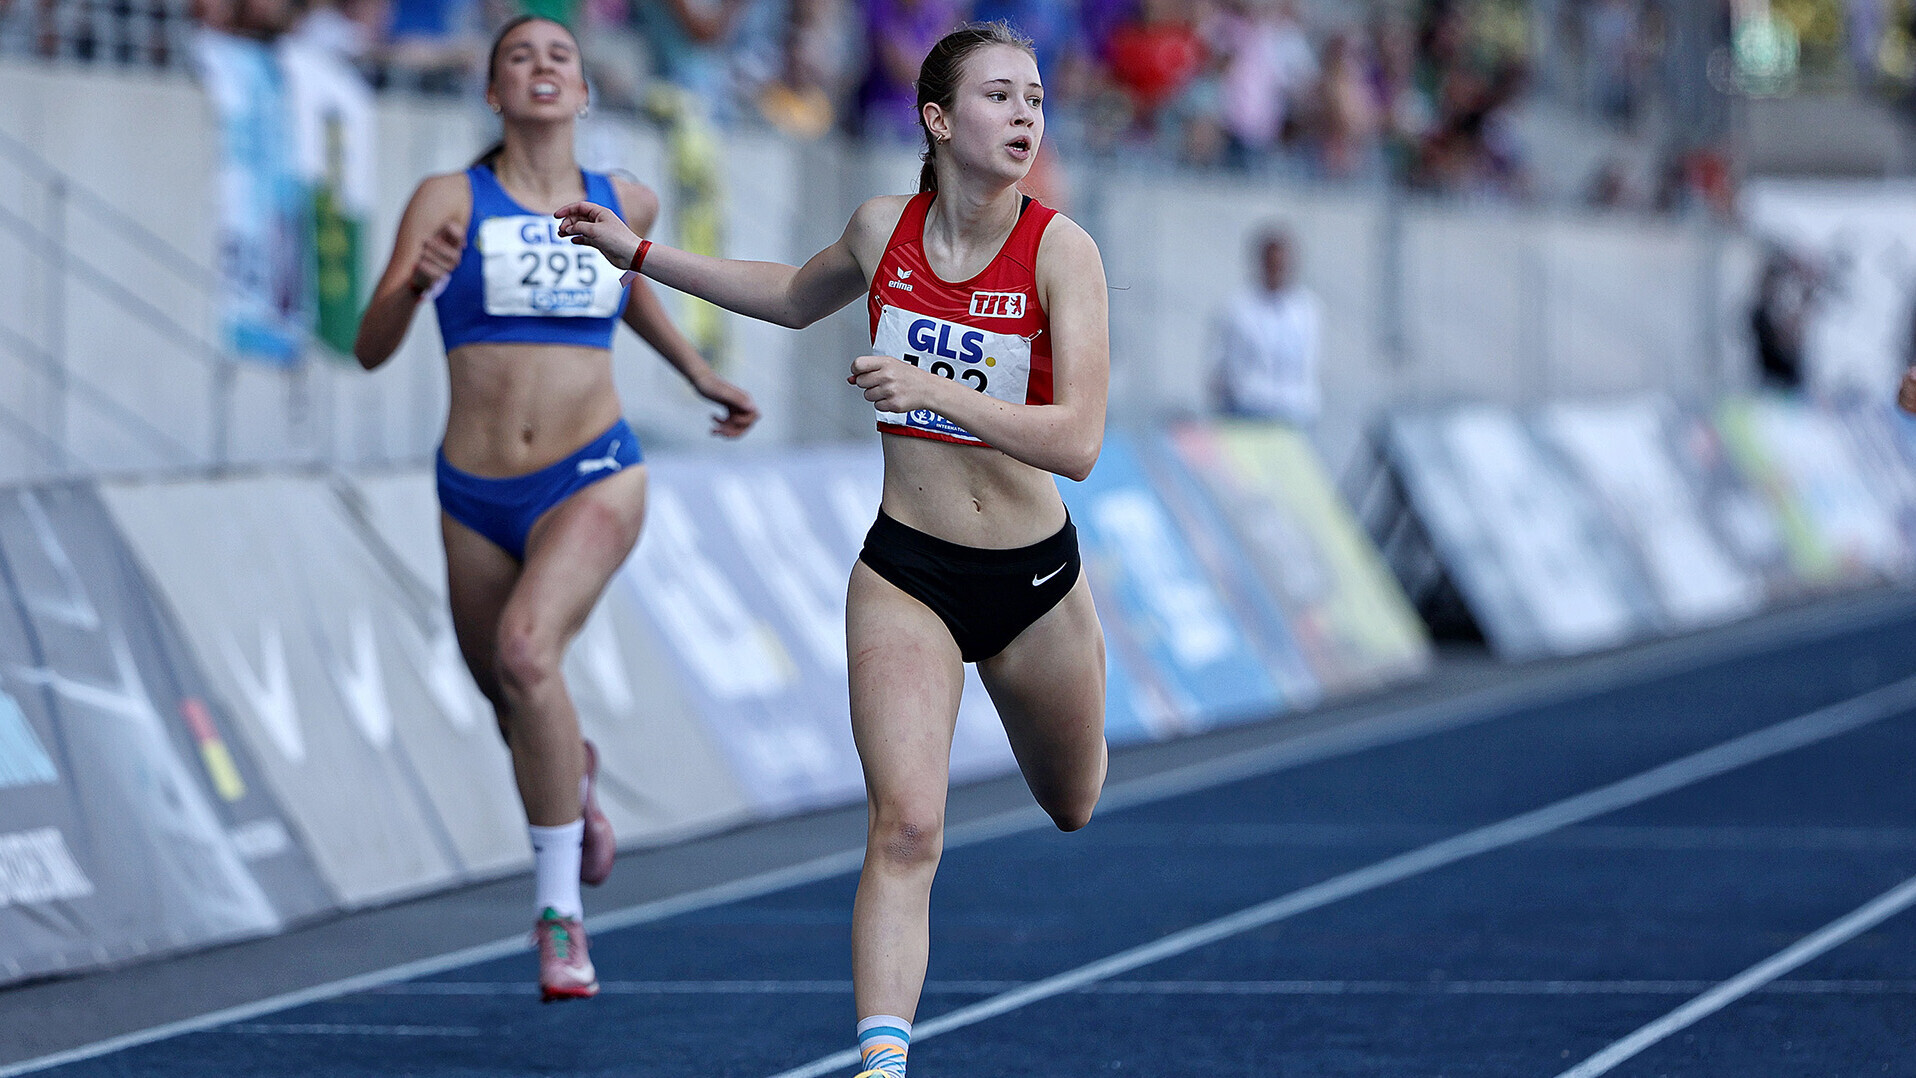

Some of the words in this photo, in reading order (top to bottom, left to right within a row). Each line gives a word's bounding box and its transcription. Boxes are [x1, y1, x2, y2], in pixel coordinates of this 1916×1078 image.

[520, 223, 566, 245] GL
[519, 251, 598, 287] 295
[888, 280, 913, 292] erima
